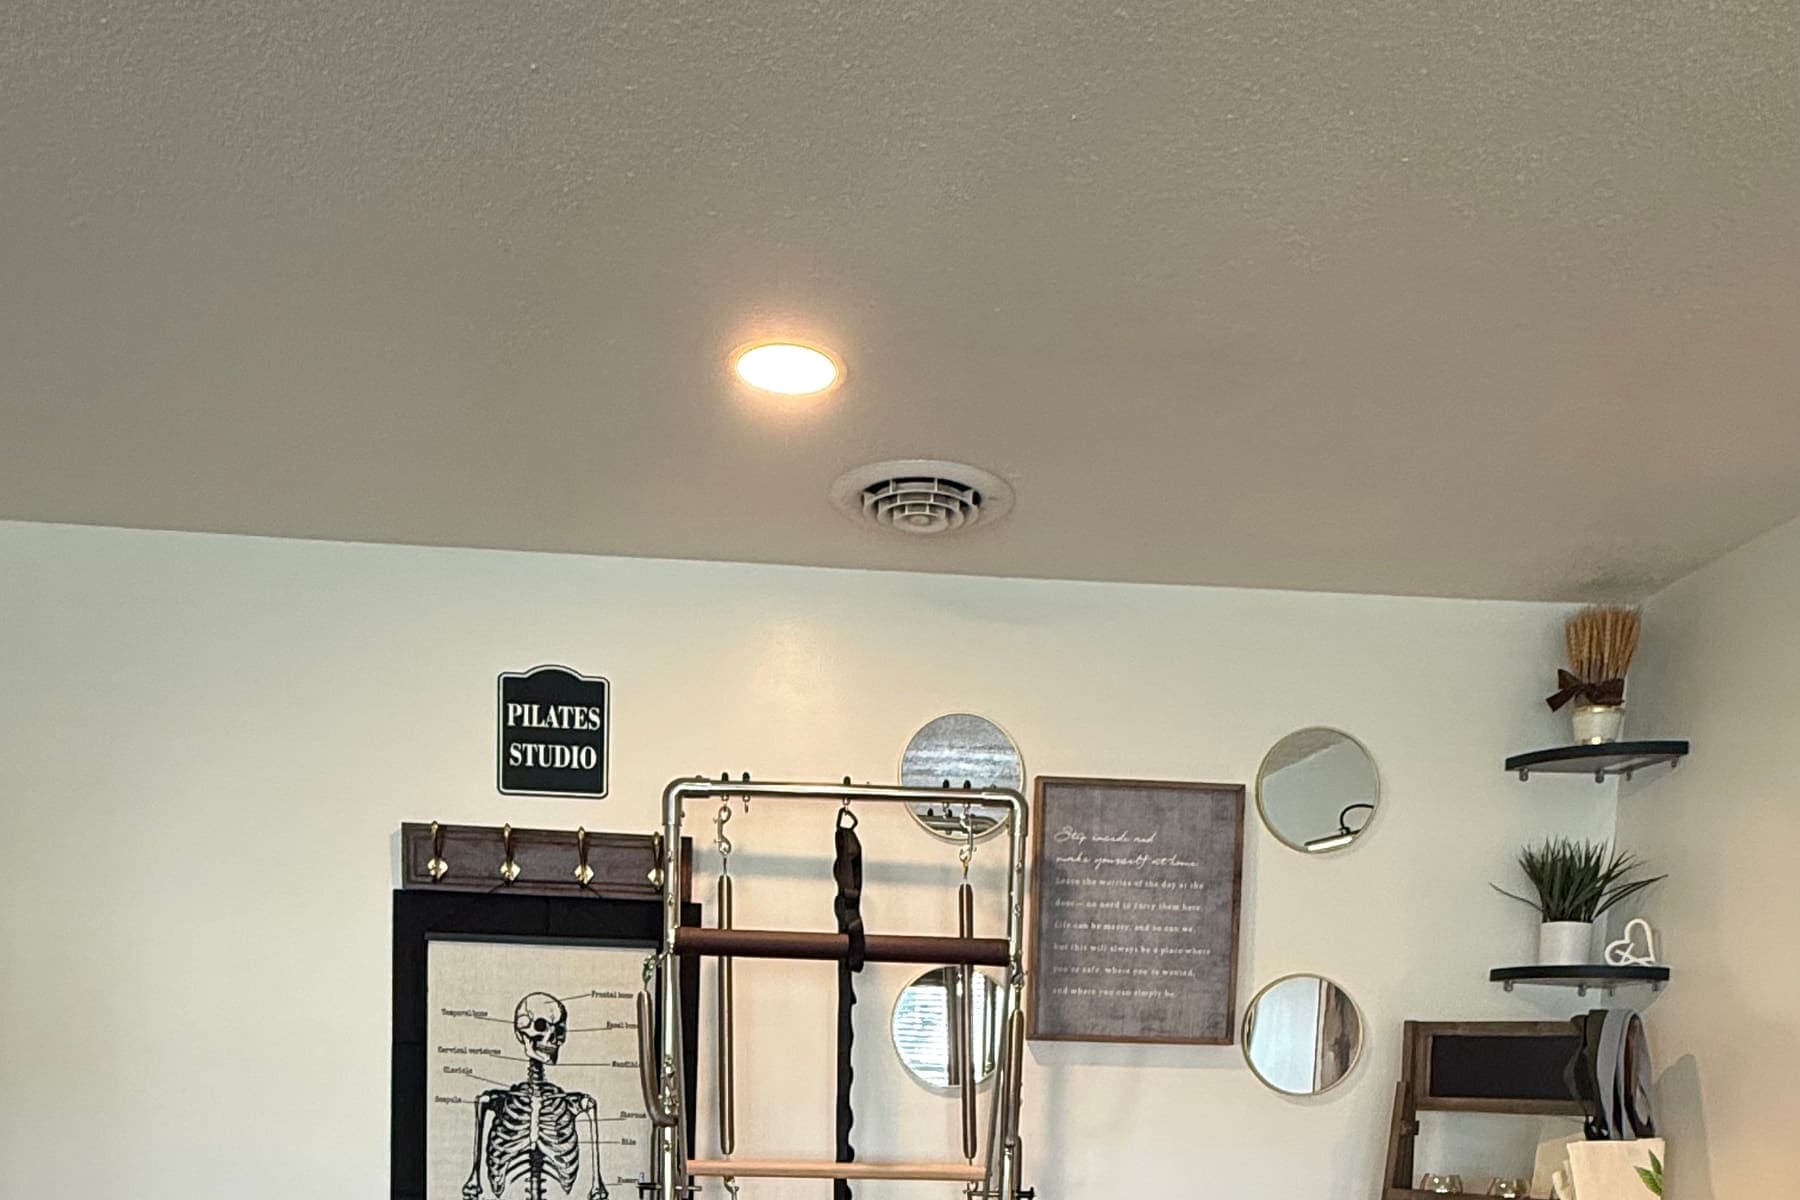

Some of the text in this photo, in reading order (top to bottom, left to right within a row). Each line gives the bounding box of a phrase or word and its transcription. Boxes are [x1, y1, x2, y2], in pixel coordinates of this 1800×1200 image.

[507, 703, 601, 730] PILATES
[509, 743, 598, 769] STUDIO
[1054, 825, 1157, 846] Step inside and
[1056, 851, 1089, 864] make
[1094, 854, 1149, 871] yourself
[1055, 877, 1080, 886] Leave
[1082, 878, 1097, 886] the
[1099, 879, 1132, 887] worries
[1133, 879, 1143, 888] of
[1145, 879, 1159, 888] the
[1161, 880, 1177, 890] day
[1189, 881, 1204, 889] the
[1099, 901, 1120, 909] need
[1122, 902, 1132, 910] to
[1158, 902, 1180, 910] them
[1054, 919, 1072, 929] Life
[1134, 924, 1150, 932] and
[1053, 942, 1069, 951] but
[1070, 944, 1088, 952] this
[1089, 944, 1108, 952] will
[1109, 944, 1139, 954] always
[1140, 945, 1151, 953] be
[1160, 946, 1184, 956] place
[1185, 947, 1212, 955] where
[1104, 966, 1131, 974] where
[592, 990, 617, 999] Frontal
[1052, 986, 1068, 995] and
[1070, 987, 1097, 995] where
[1098, 989, 1115, 998] you
[1134, 989, 1162, 999] simply
[441, 1008, 472, 1018] Temporal
[438, 1046, 467, 1054] Cervical
